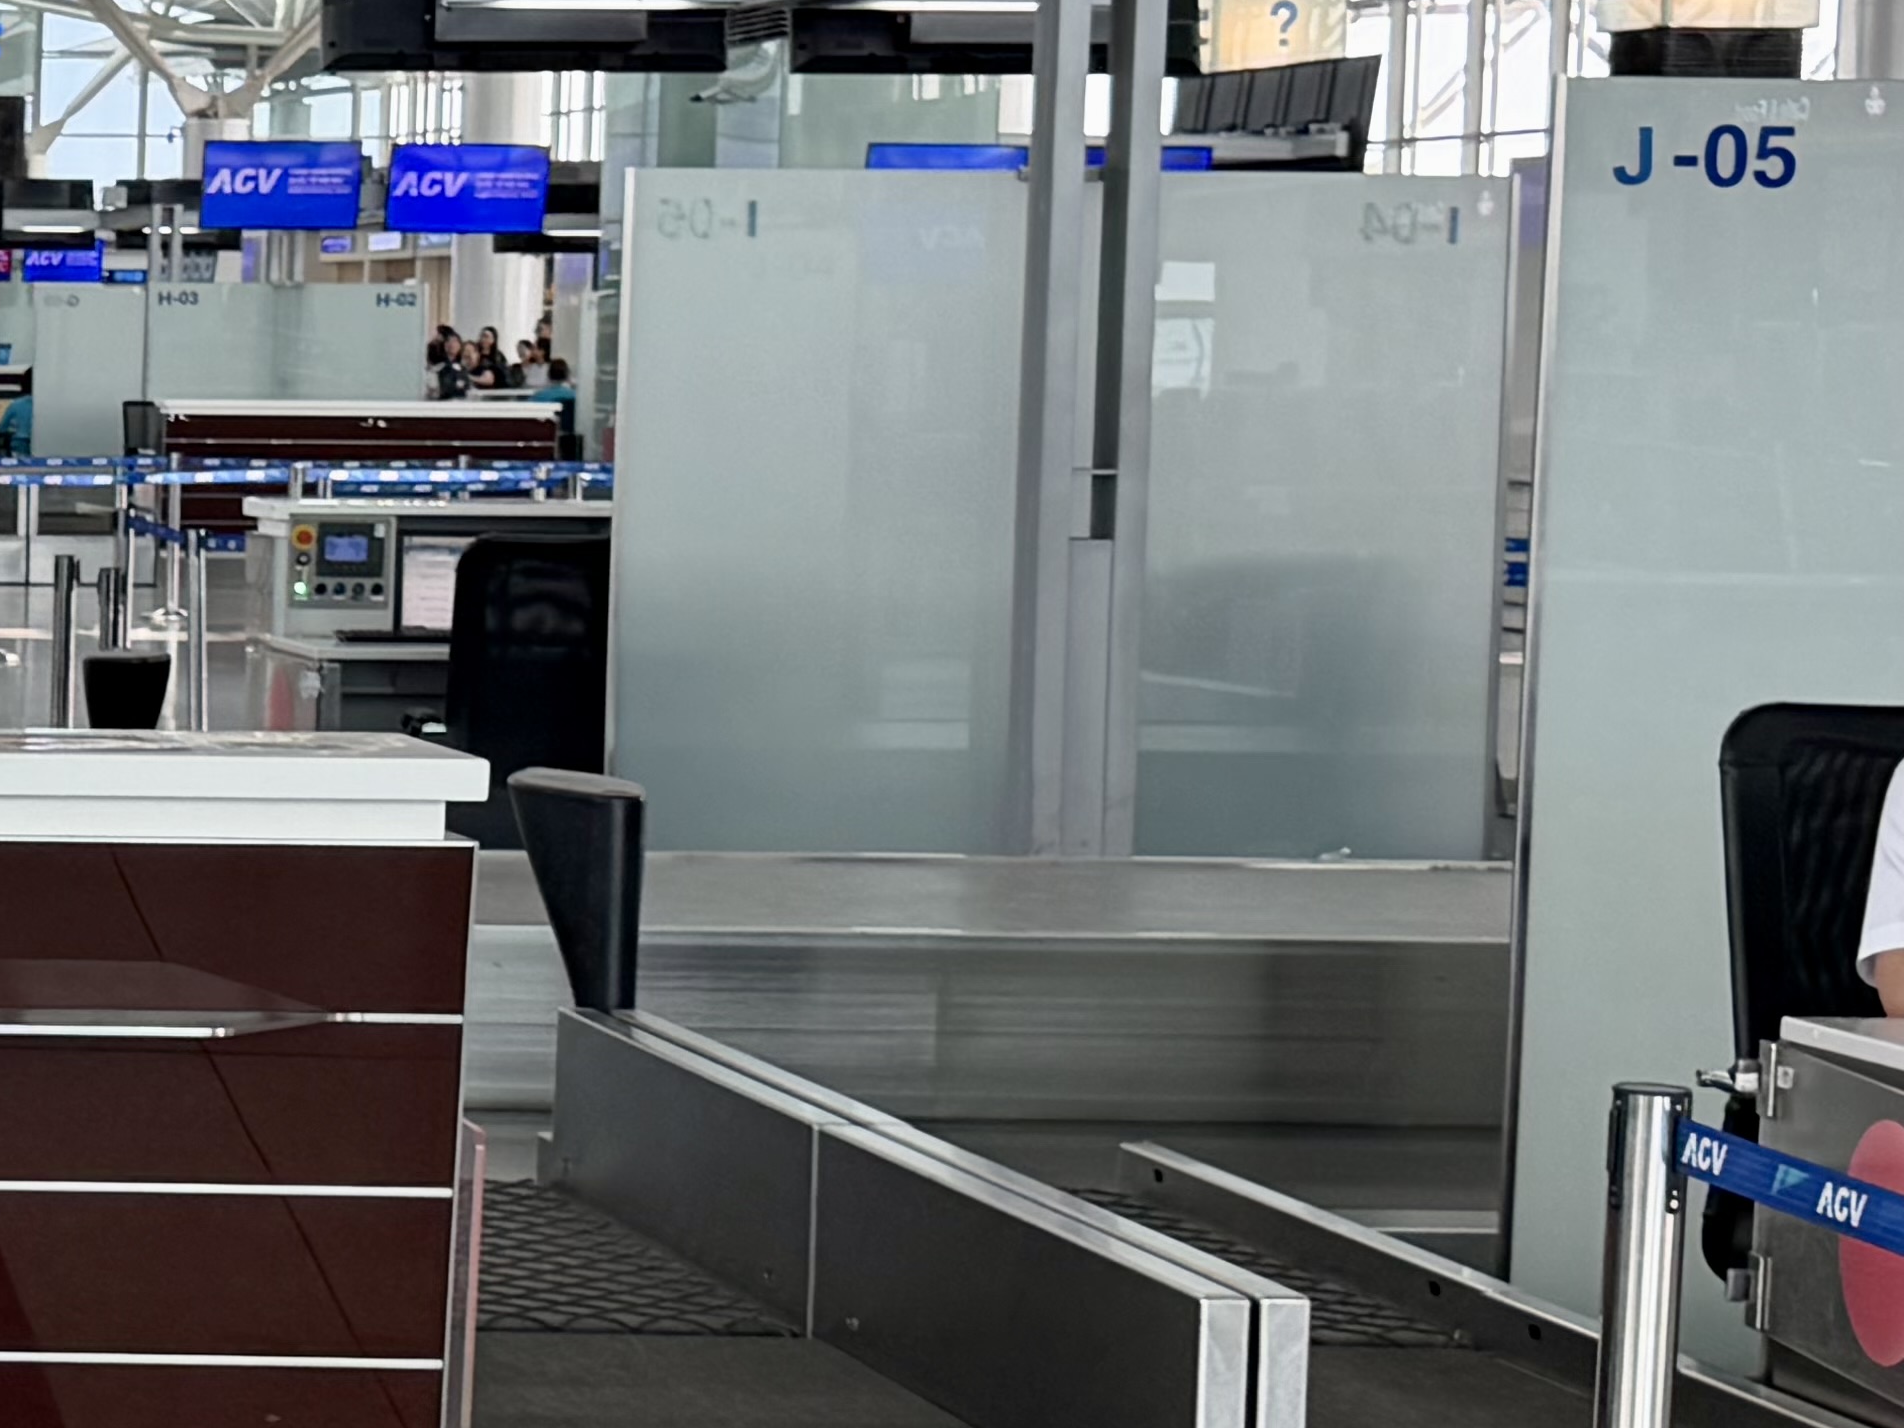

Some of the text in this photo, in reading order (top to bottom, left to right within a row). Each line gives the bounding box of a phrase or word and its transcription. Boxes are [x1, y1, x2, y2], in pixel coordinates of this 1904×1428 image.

[1612, 124, 1796, 189] J-05
[206, 167, 282, 194] ACV
[392, 171, 470, 198] ACV
[158, 291, 199, 306] H-03
[1681, 1132, 1729, 1176] ACV
[1816, 1181, 1868, 1229] ACV
